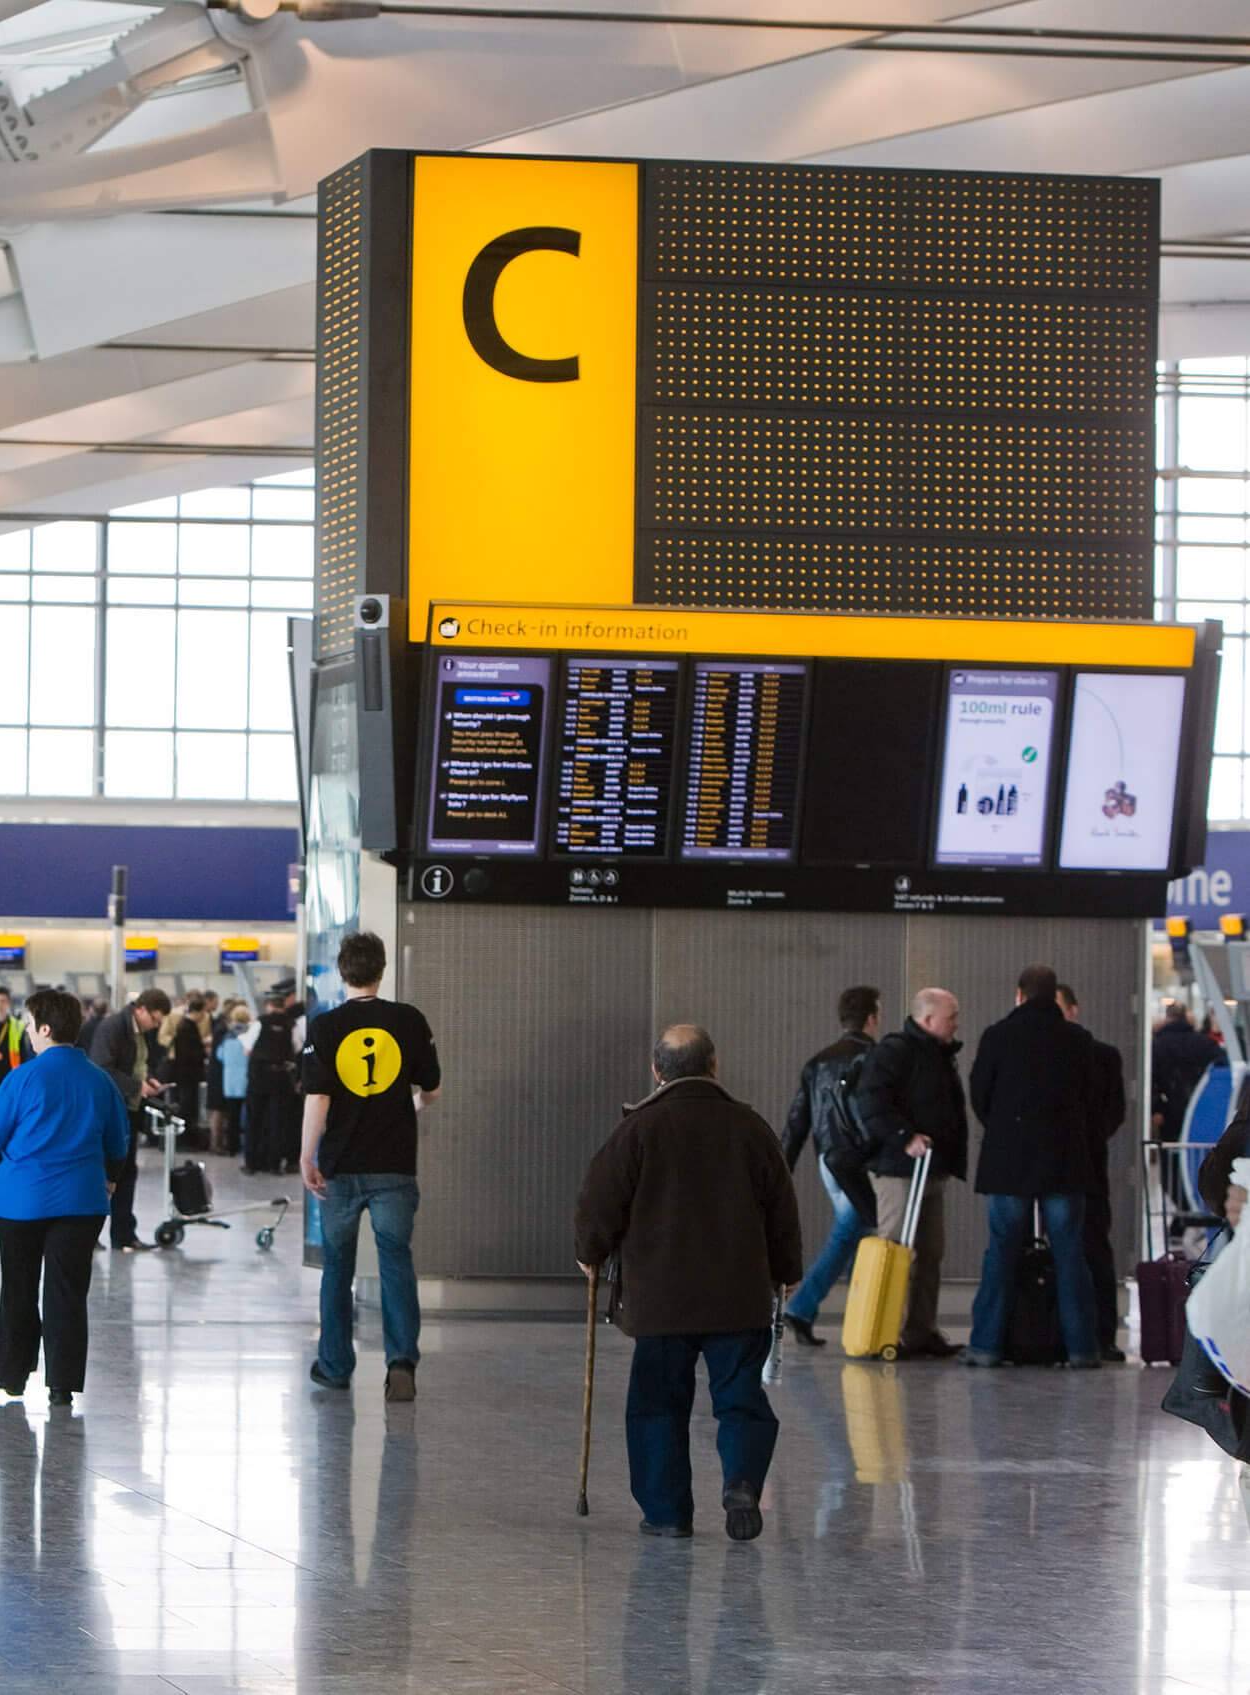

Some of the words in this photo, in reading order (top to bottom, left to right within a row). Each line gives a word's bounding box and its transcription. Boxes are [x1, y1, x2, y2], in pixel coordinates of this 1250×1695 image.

[462, 225, 581, 383] C
[467, 618, 558, 637] Check-in
[563, 620, 689, 641] information
[960, 700, 1007, 714] 100ml
[1011, 701, 1042, 715] rule
